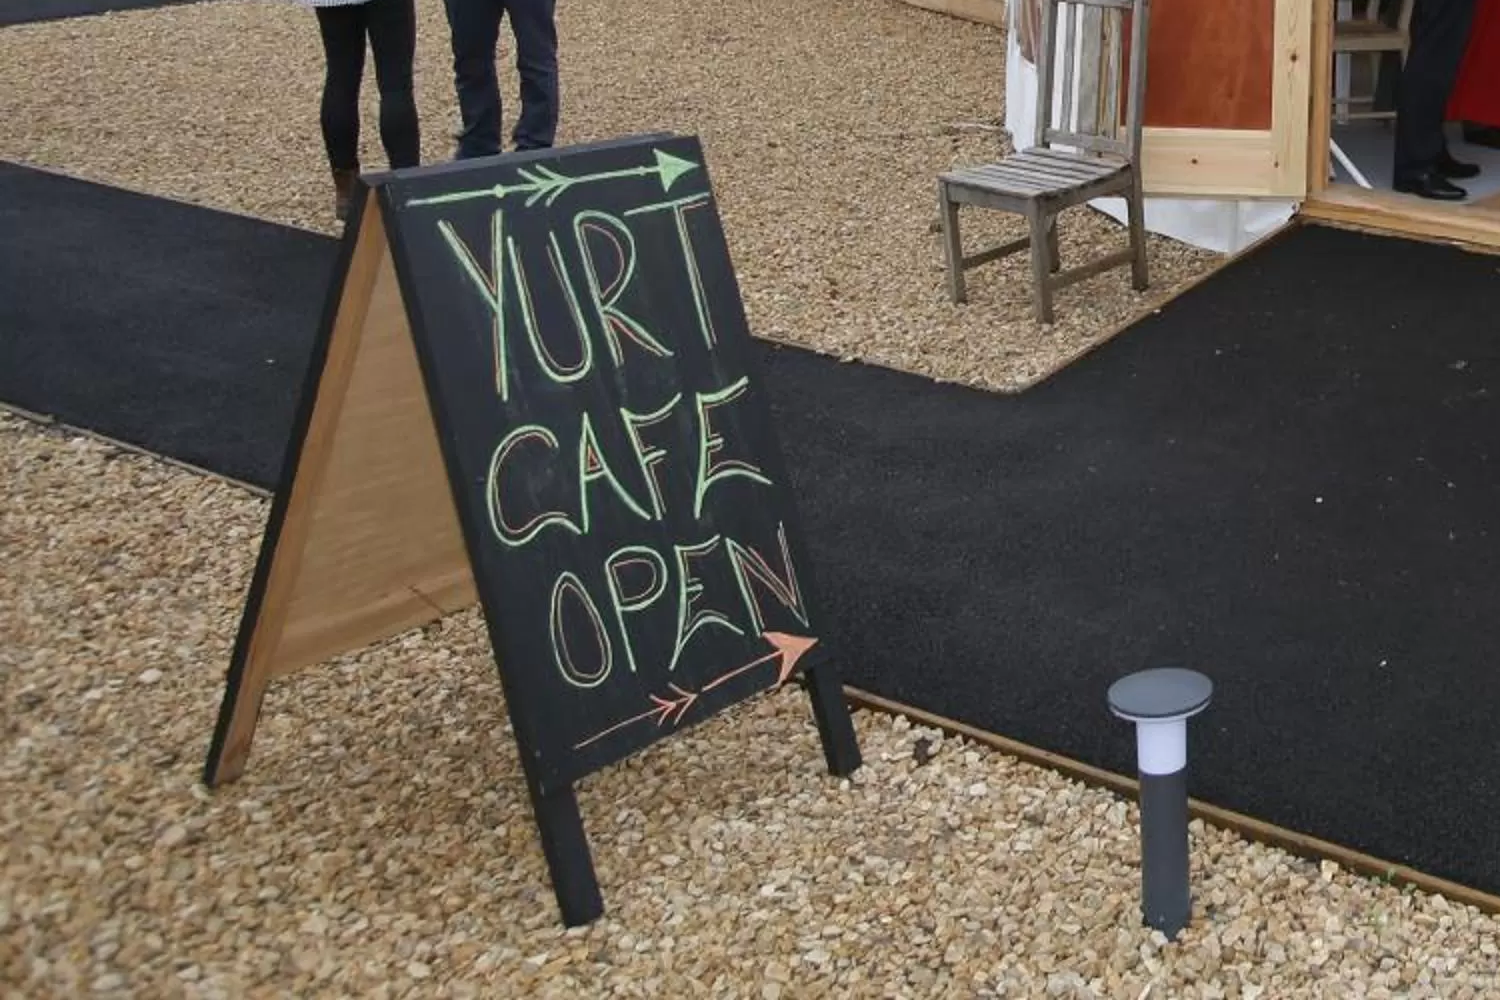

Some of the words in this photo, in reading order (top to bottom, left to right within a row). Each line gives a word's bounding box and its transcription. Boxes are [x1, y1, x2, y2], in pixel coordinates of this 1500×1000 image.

[437, 193, 716, 401] YURT
[486, 376, 773, 547] CAFE
[549, 522, 810, 688] OPEN
